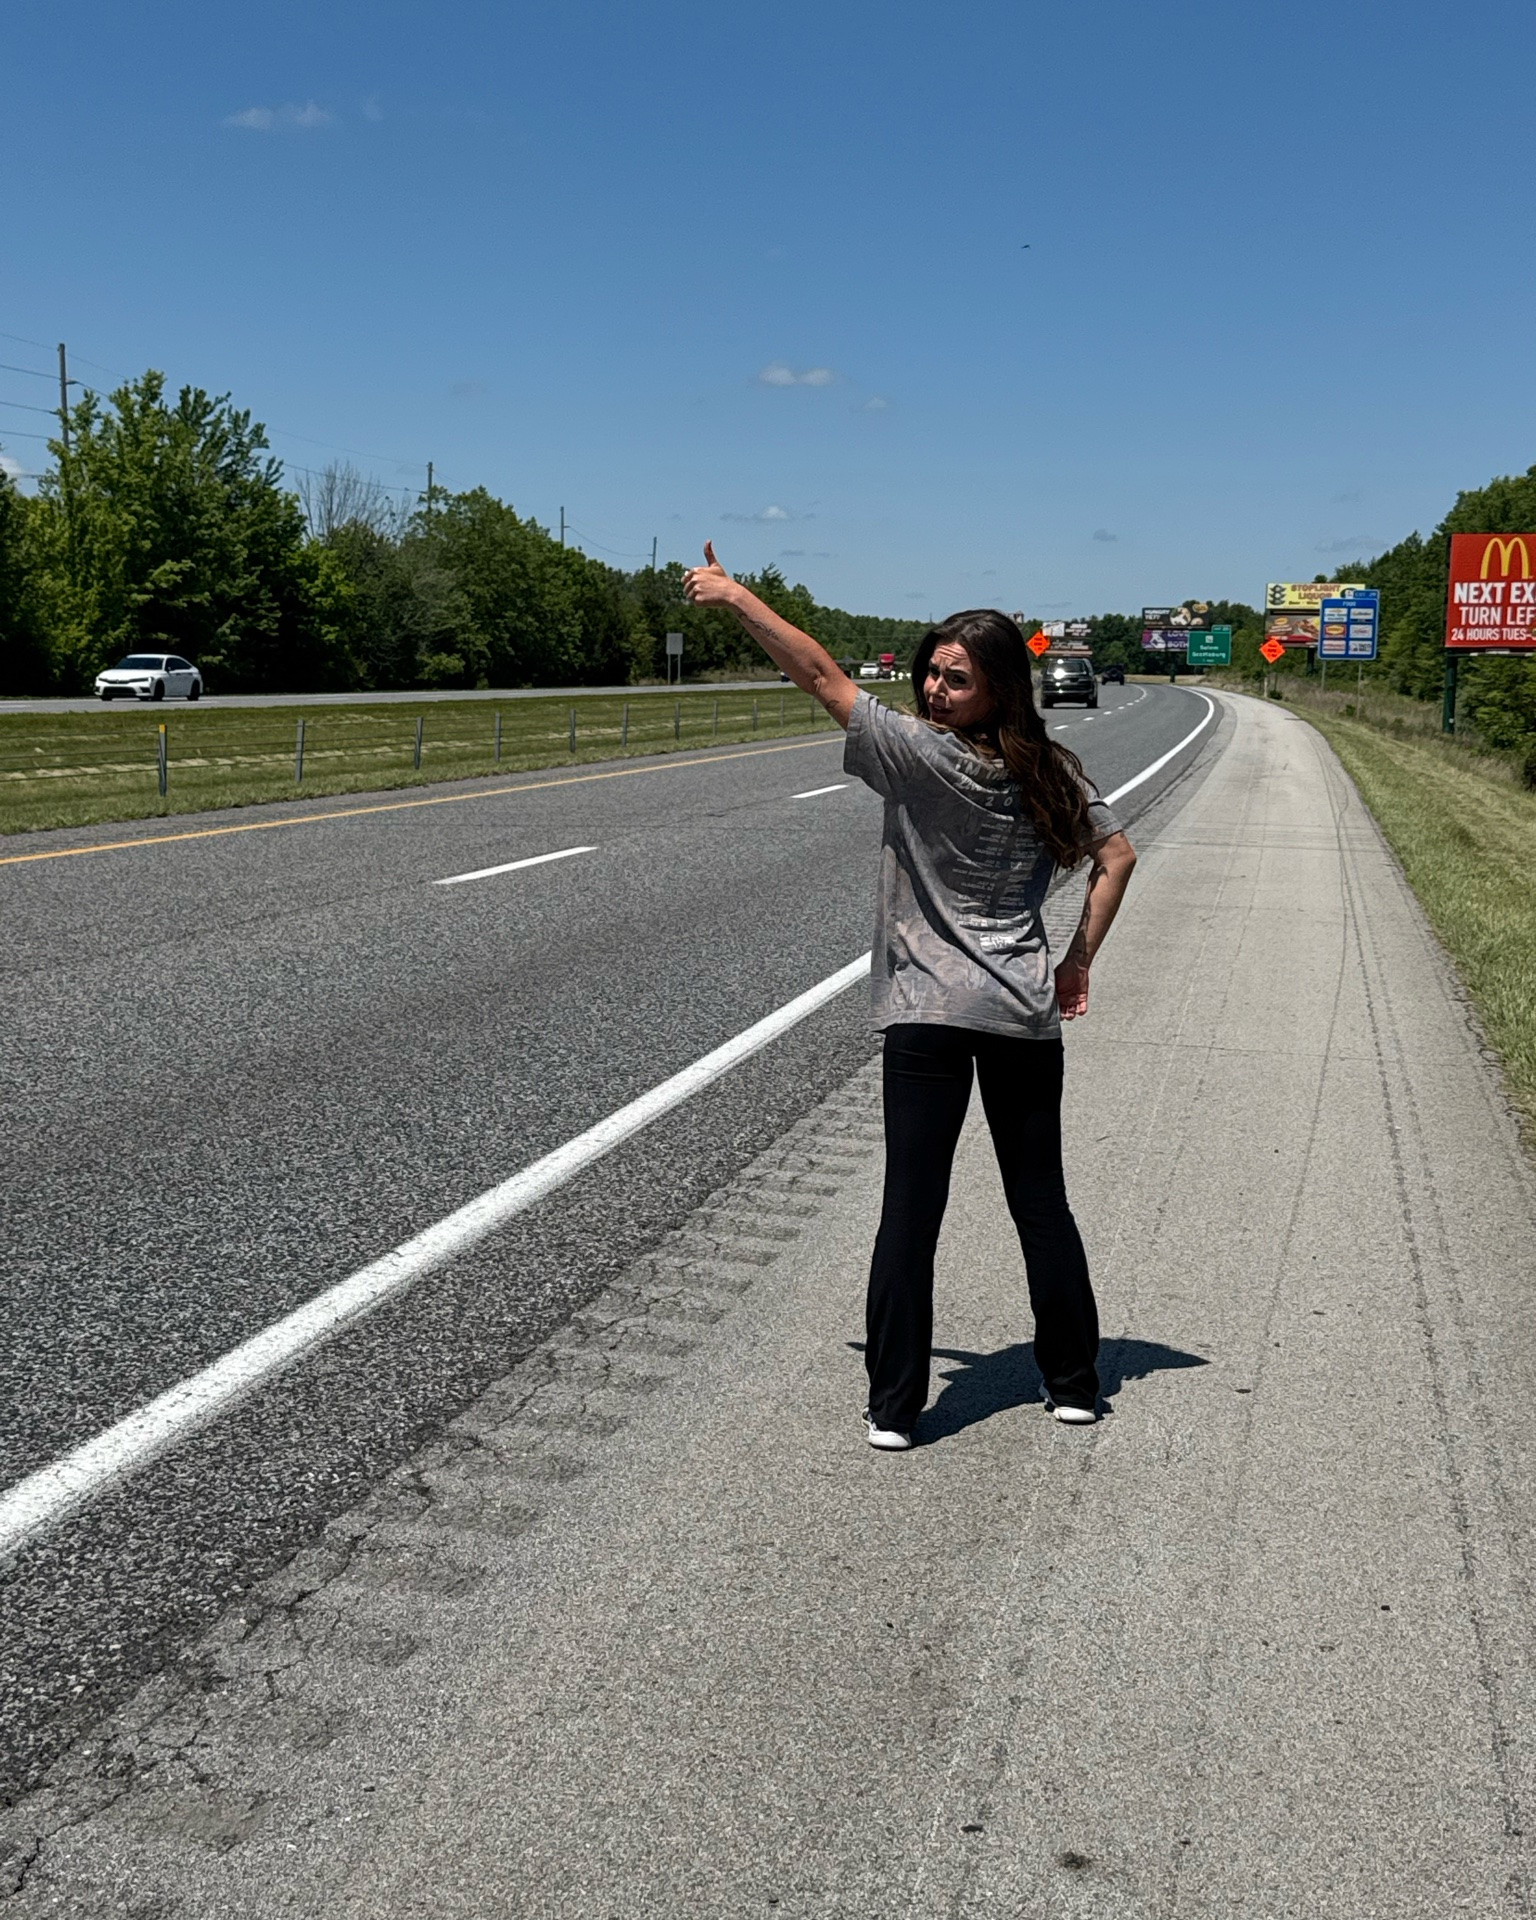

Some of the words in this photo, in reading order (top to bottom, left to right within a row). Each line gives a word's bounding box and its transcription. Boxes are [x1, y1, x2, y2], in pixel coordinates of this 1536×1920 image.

[1291, 584, 1341, 592] STOPLIGHT
[1453, 582, 1506, 604] NEXT
[1509, 582, 1536, 604] EX
[1459, 606, 1502, 625] TURN
[1506, 606, 1536, 625] LEF
[1451, 628, 1464, 641] 24
[1466, 628, 1500, 641] HOURS
